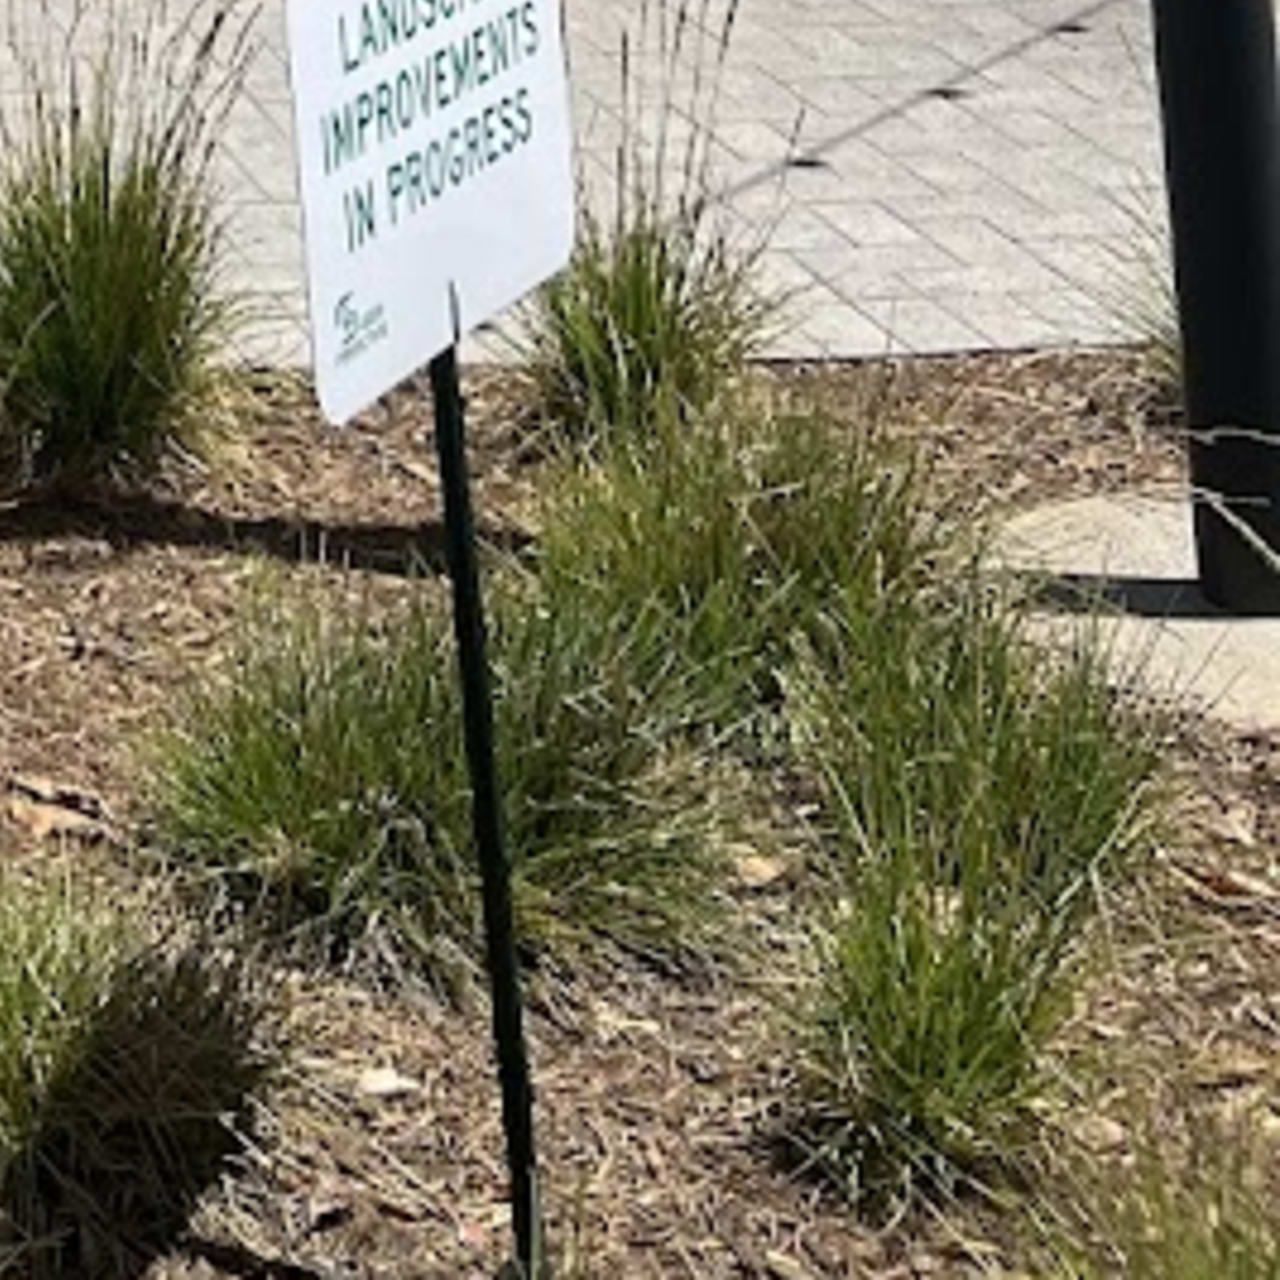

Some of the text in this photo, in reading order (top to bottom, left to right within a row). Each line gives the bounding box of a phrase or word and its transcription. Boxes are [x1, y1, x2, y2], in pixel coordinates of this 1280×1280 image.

[319, 1, 539, 176] IMPROVEMENTS
[342, 87, 534, 252] IN PROGRESS
